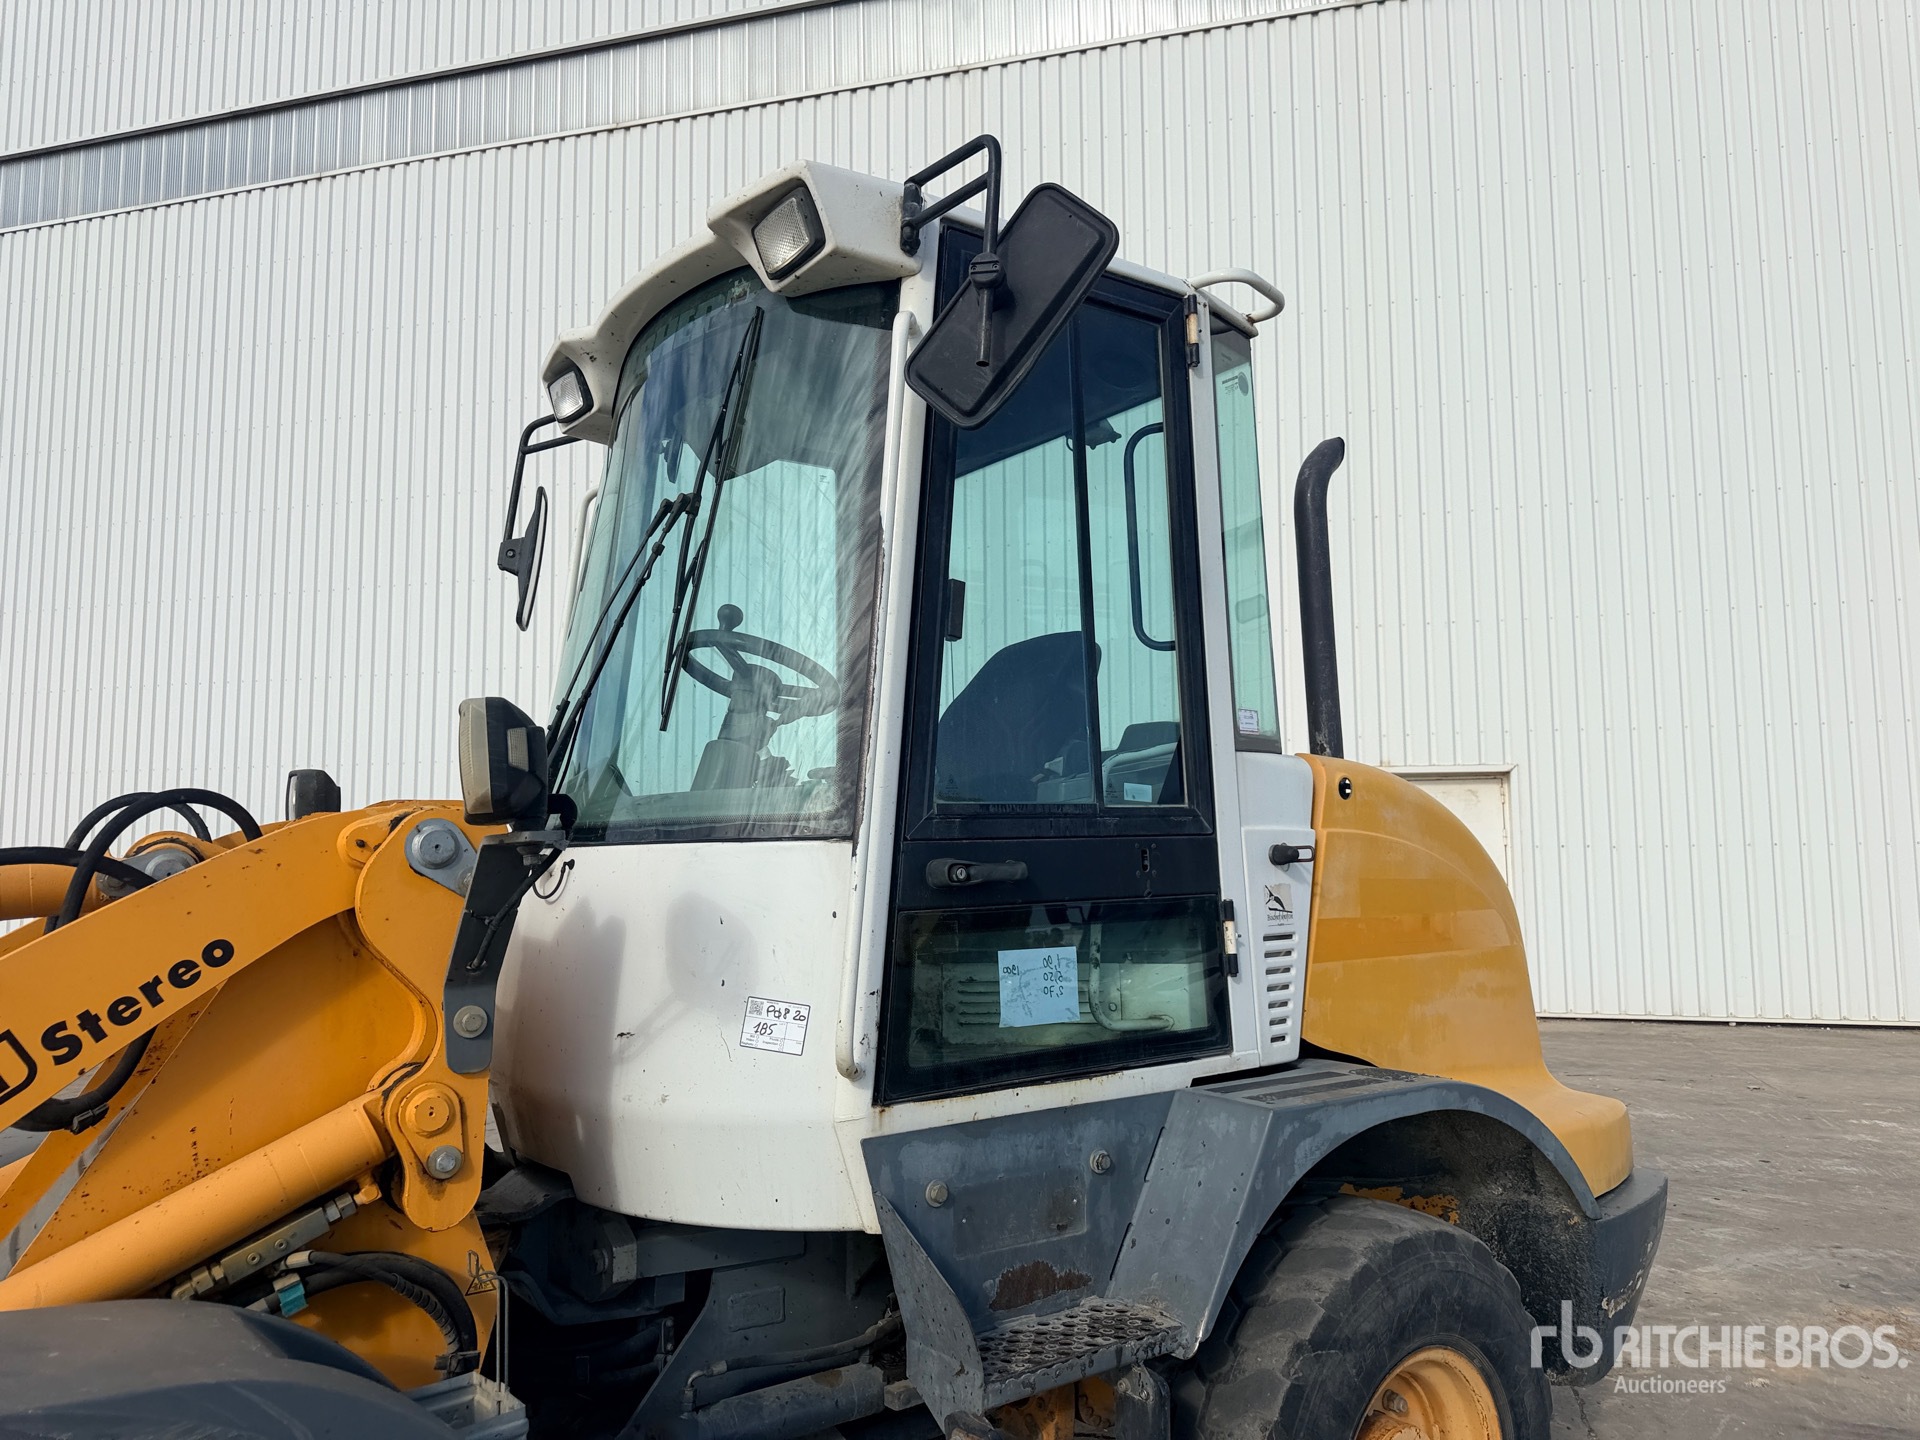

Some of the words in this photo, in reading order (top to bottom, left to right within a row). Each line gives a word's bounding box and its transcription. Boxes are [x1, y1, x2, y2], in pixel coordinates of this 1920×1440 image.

[41, 939, 235, 1066] Stereo
[792, 1010, 807, 1022] 20
[753, 1022, 778, 1036] 185
